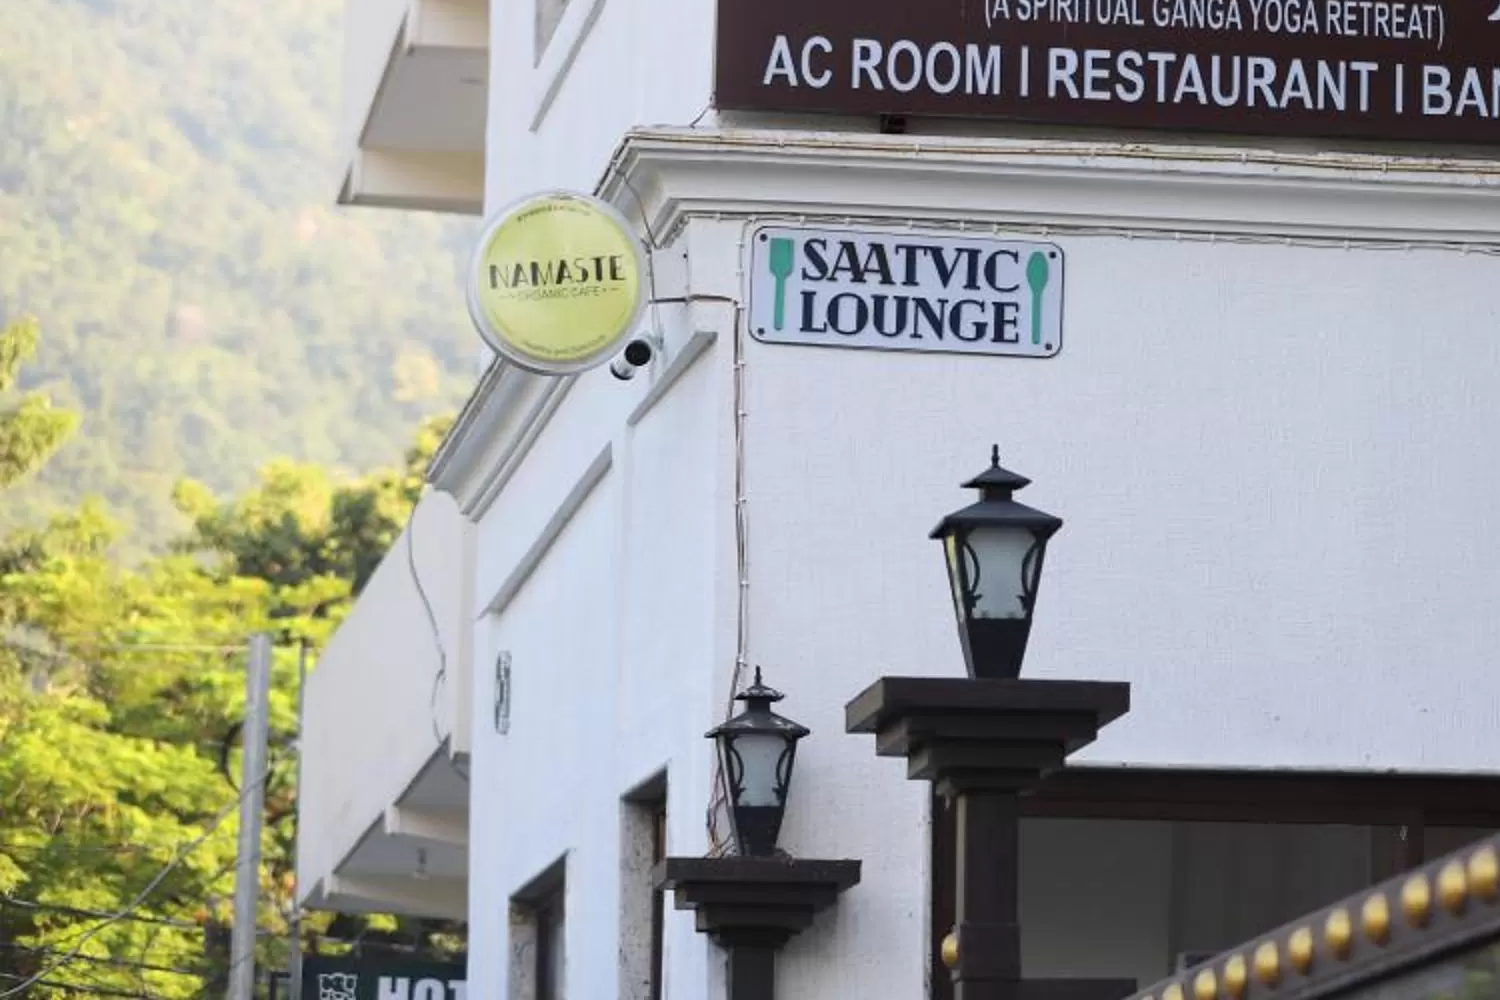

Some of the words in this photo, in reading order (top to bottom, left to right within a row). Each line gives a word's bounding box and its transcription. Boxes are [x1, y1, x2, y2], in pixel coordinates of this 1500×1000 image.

[1326, 0, 1444, 51] RETREAT)
[762, 35, 833, 89] AC
[852, 38, 1002, 96] ROOM
[1047, 48, 1379, 113] RESTAURANT
[489, 255, 626, 289] NAMASTE
[801, 238, 1020, 292] SAATVIC
[800, 290, 1020, 343] LOUNGE
